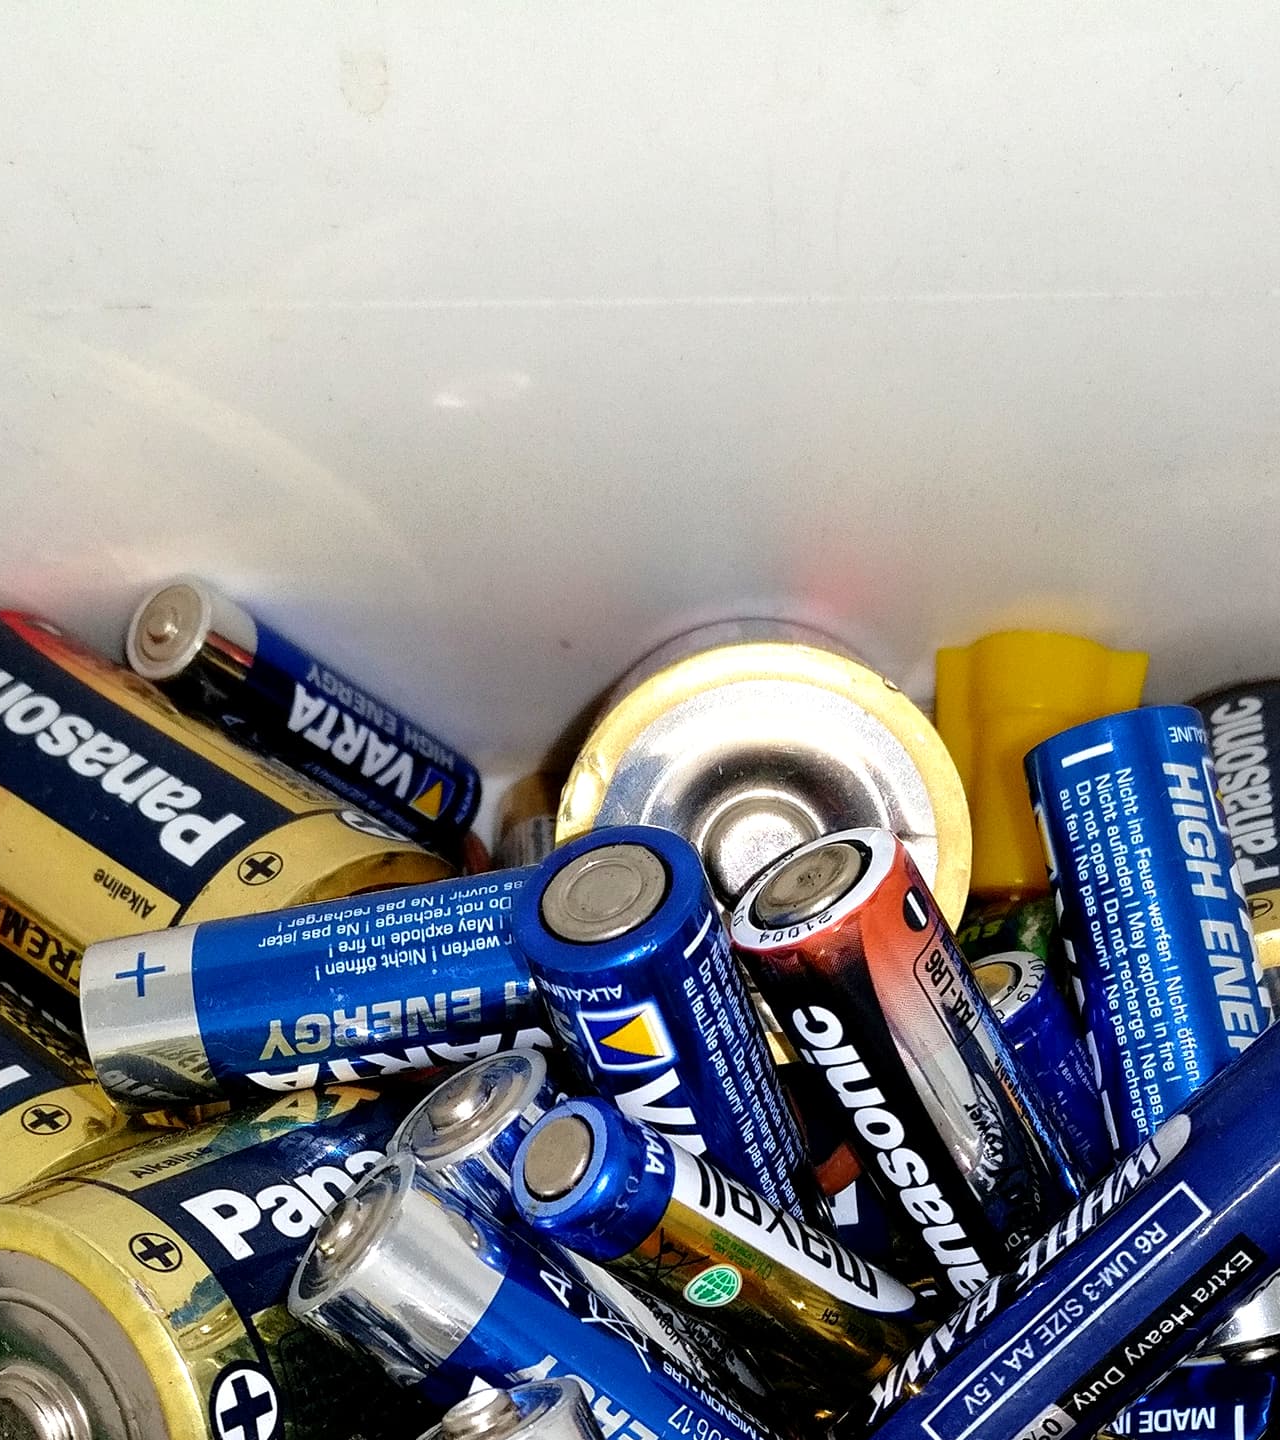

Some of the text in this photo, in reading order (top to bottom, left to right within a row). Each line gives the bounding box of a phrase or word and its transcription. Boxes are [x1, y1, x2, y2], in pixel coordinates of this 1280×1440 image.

[287, 683, 420, 798] VARTA
[1211, 696, 1280, 884] Panasonic
[1162, 762, 1229, 900] HIGH
[92, 866, 157, 920] Alkaline
[291, 905, 371, 928] recharger
[375, 904, 452, 927] recharge
[391, 917, 494, 946] May explode
[1096, 773, 1118, 823] Nicht
[1124, 908, 1146, 950] May
[1137, 954, 1163, 1018] explode
[1116, 767, 1139, 817] Nicht
[1166, 976, 1188, 1024] Nicht
[381, 937, 501, 967] werfen Nicht
[1090, 842, 1146, 1040] open recharge
[259, 986, 482, 1061] ENERGY
[925, 949, 972, 1028] AA-LR6
[1091, 920, 1150, 1135] ouvrir recharger
[792, 1004, 994, 1298] anasonic
[696, 1155, 880, 1305] maxell
[1191, 1249, 1255, 1307] Extra
[963, 1220, 1169, 1417] R6 UM-3 SIZE AA 1.5V
[1124, 1301, 1195, 1366] Heavy
[1072, 1362, 1127, 1412] Duty
[1138, 1407, 1216, 1434] MADE
